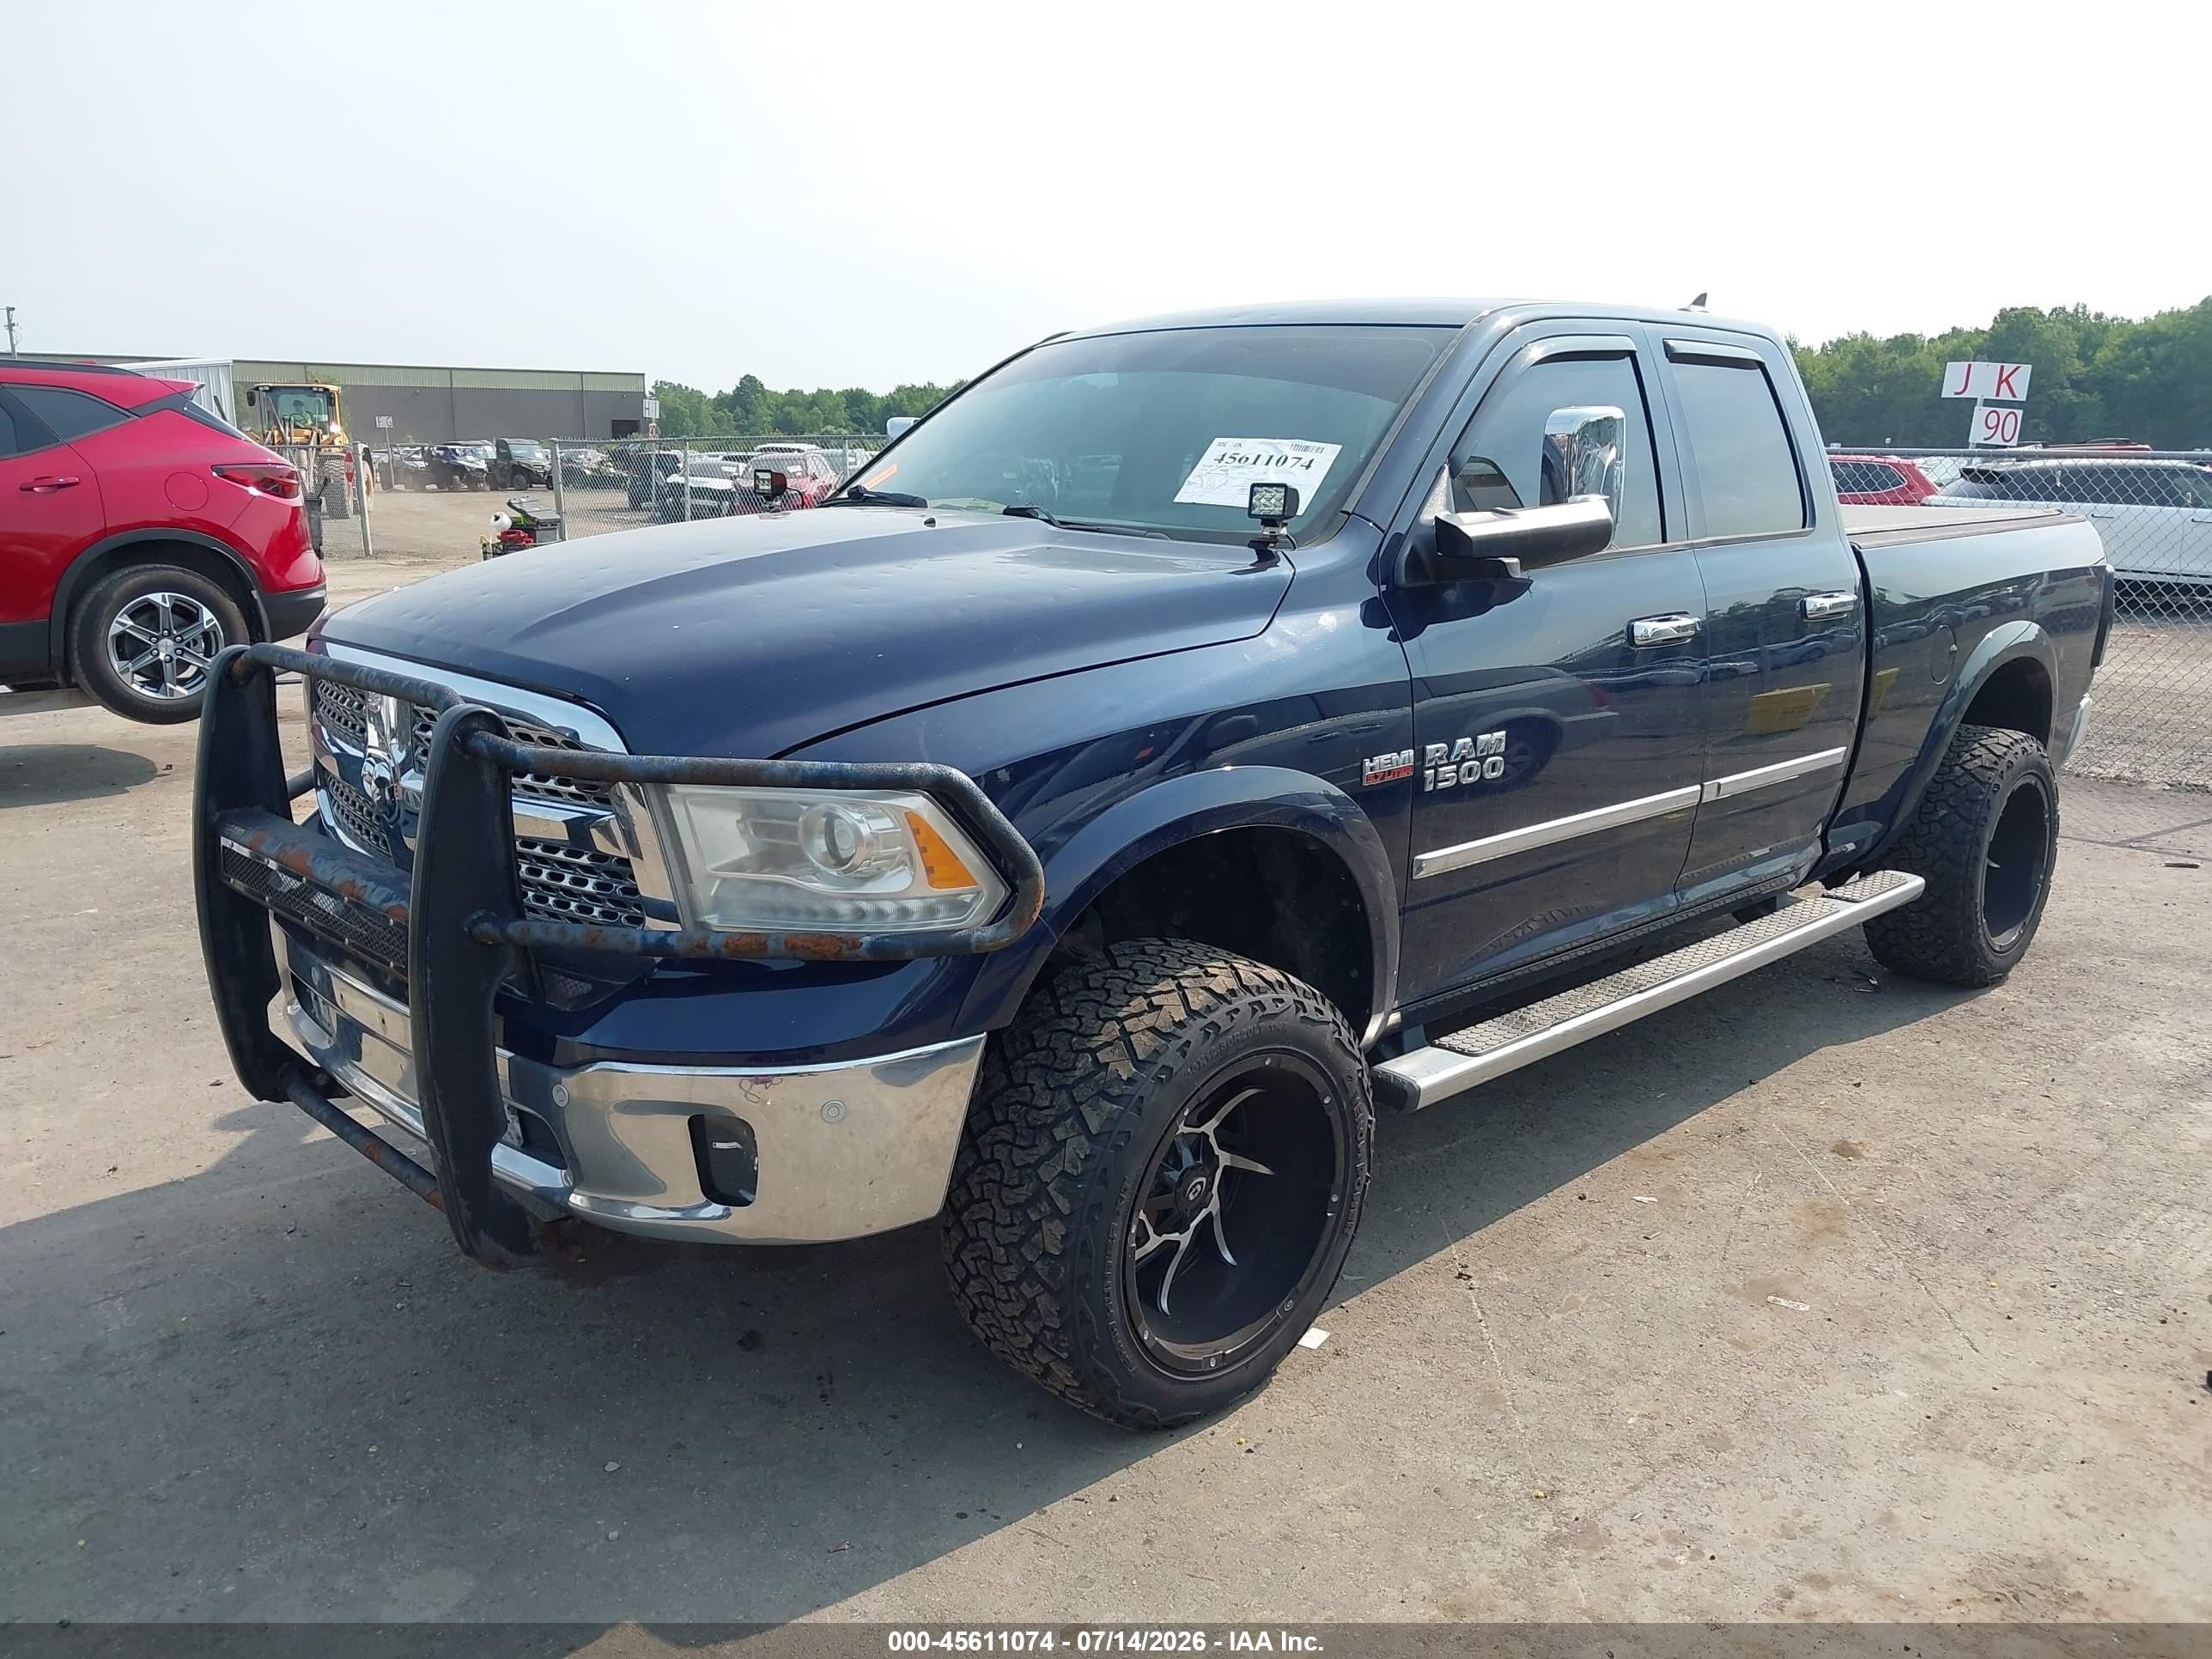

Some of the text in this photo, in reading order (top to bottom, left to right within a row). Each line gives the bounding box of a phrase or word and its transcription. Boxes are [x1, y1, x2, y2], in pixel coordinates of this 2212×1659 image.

[1954, 363, 2021, 398] J K
[1983, 410, 2019, 443] 90
[1213, 452, 1315, 471] 45611074
[1363, 749, 1415, 775] HEMI
[1424, 730, 1507, 768] RAM
[1424, 756, 1505, 793] 1500
